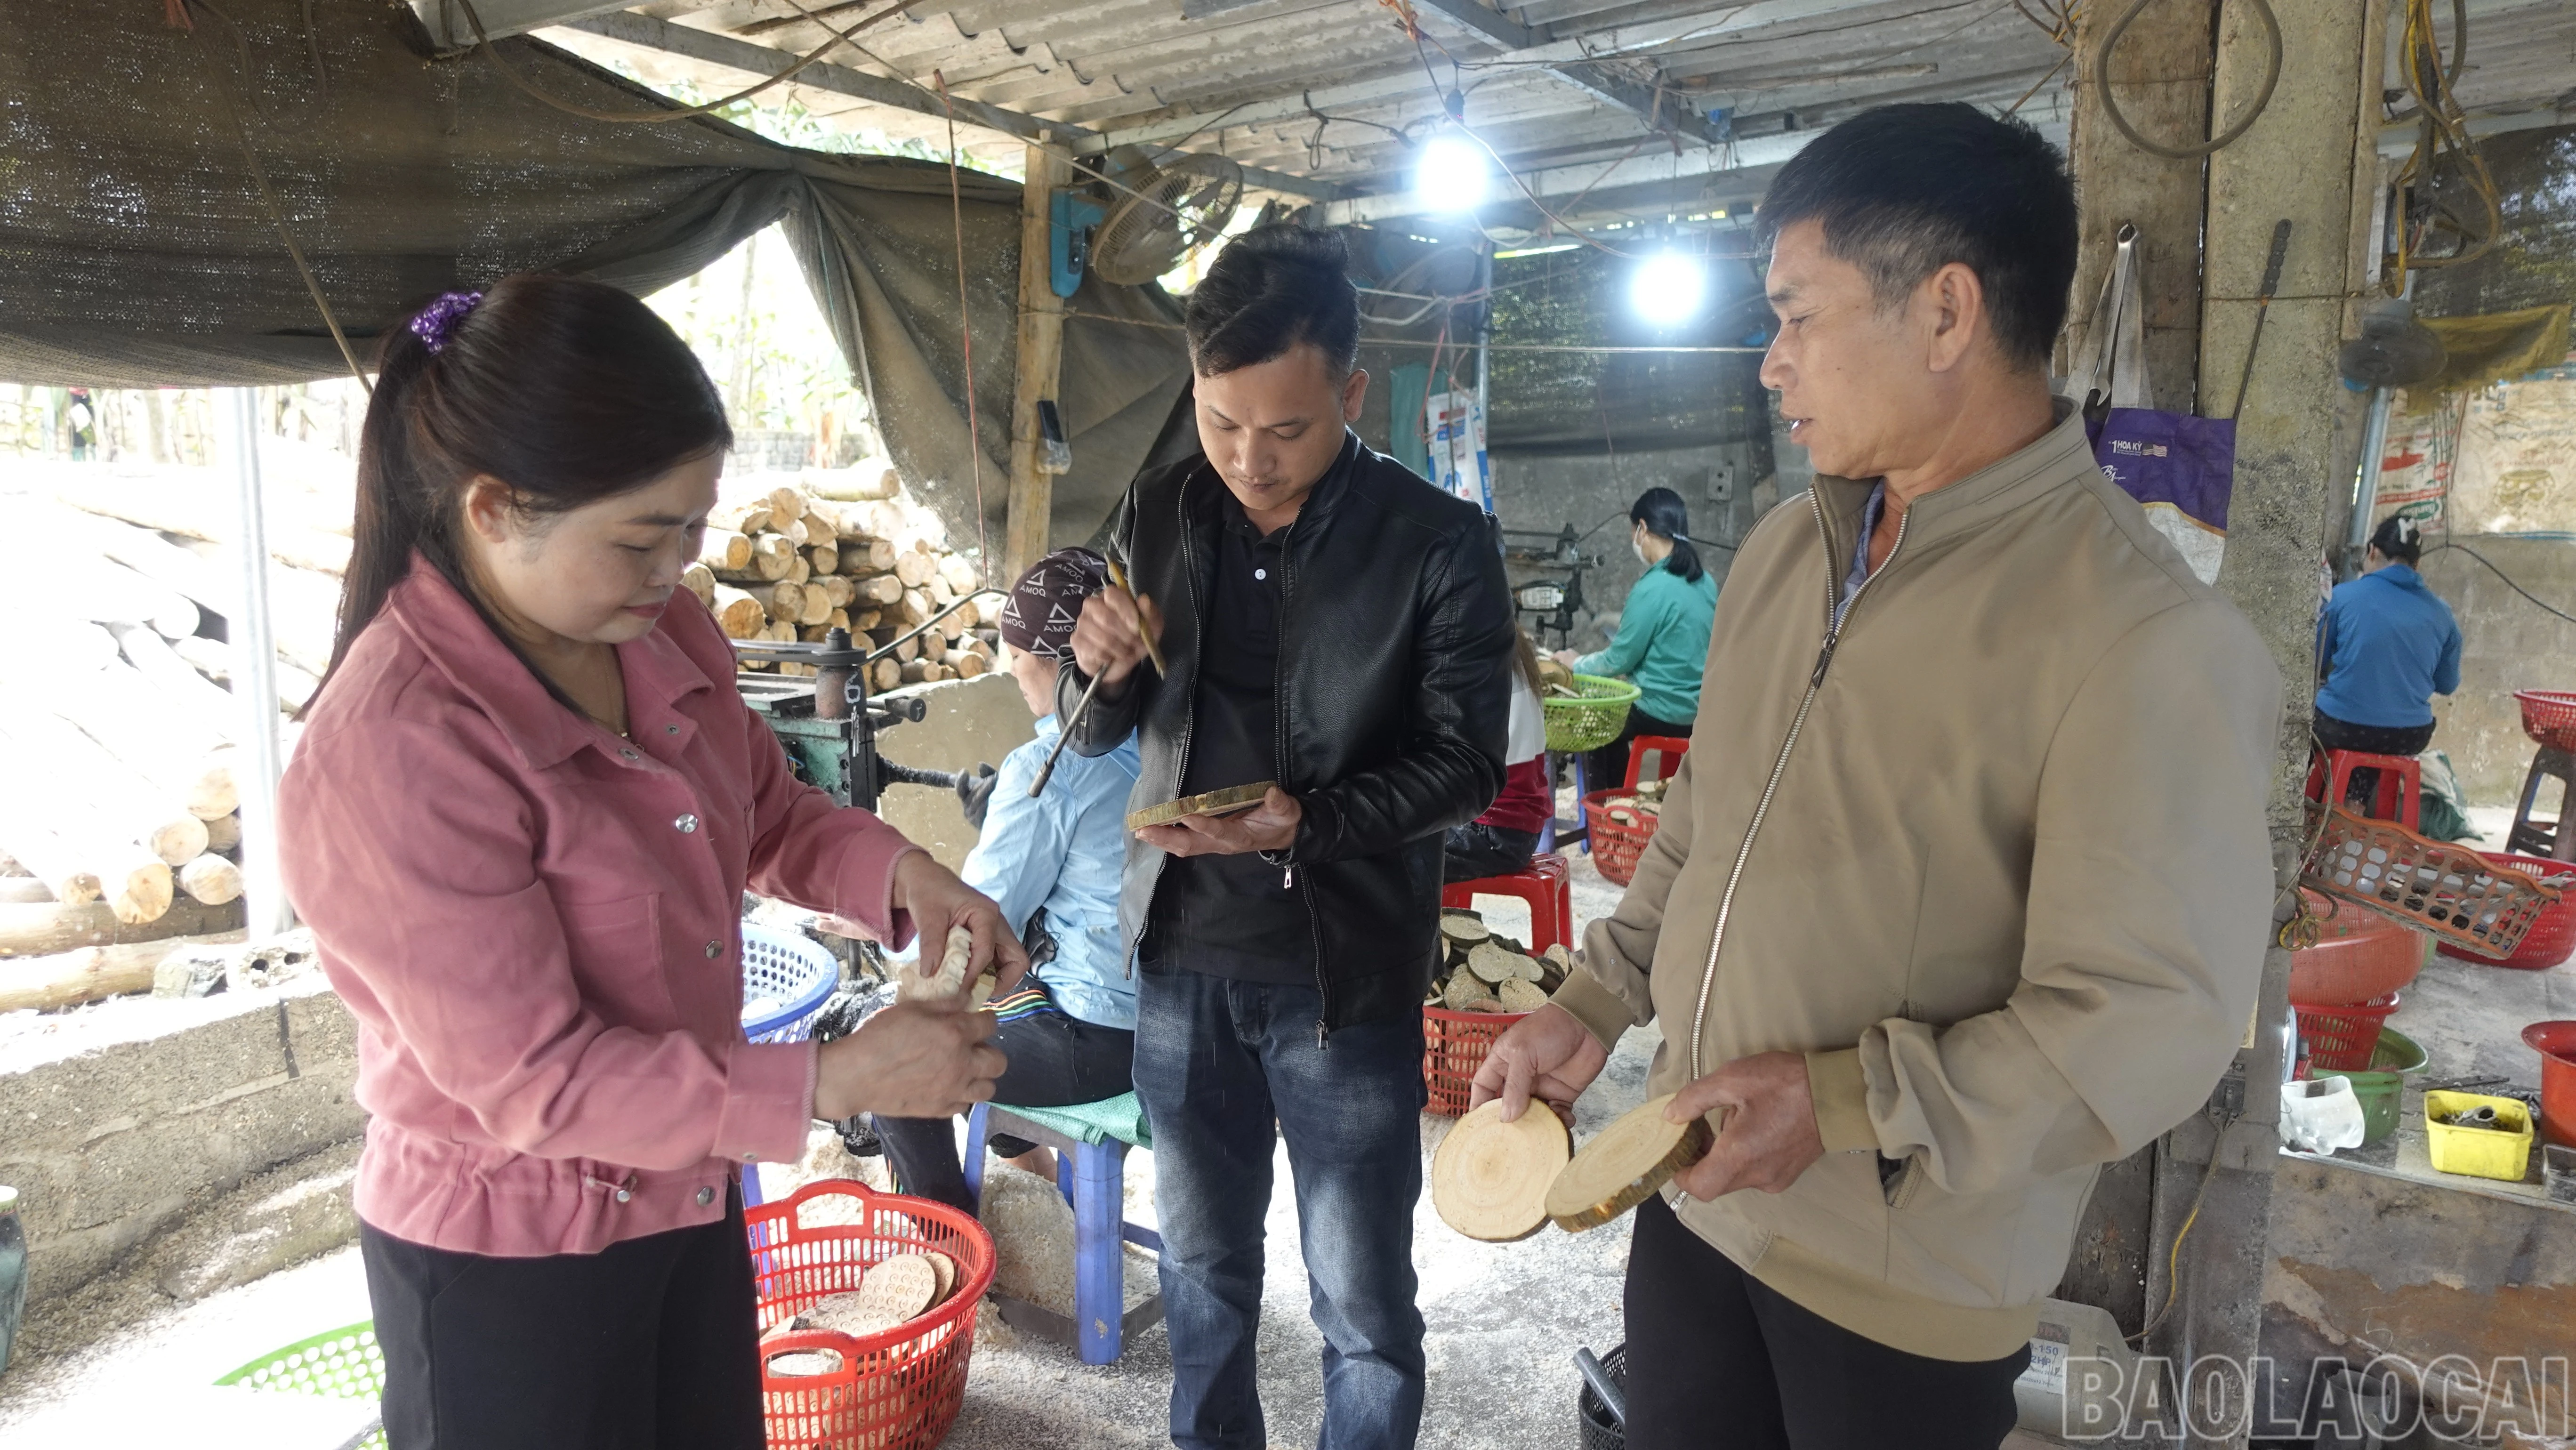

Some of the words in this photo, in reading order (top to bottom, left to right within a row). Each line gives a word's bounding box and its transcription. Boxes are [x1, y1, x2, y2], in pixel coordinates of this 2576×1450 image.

[2117, 440, 2131, 451] HOA
[1019, 584, 1046, 597] AMOQ
[1001, 616, 1026, 630] AMOQ
[844, 670, 861, 704] 6
